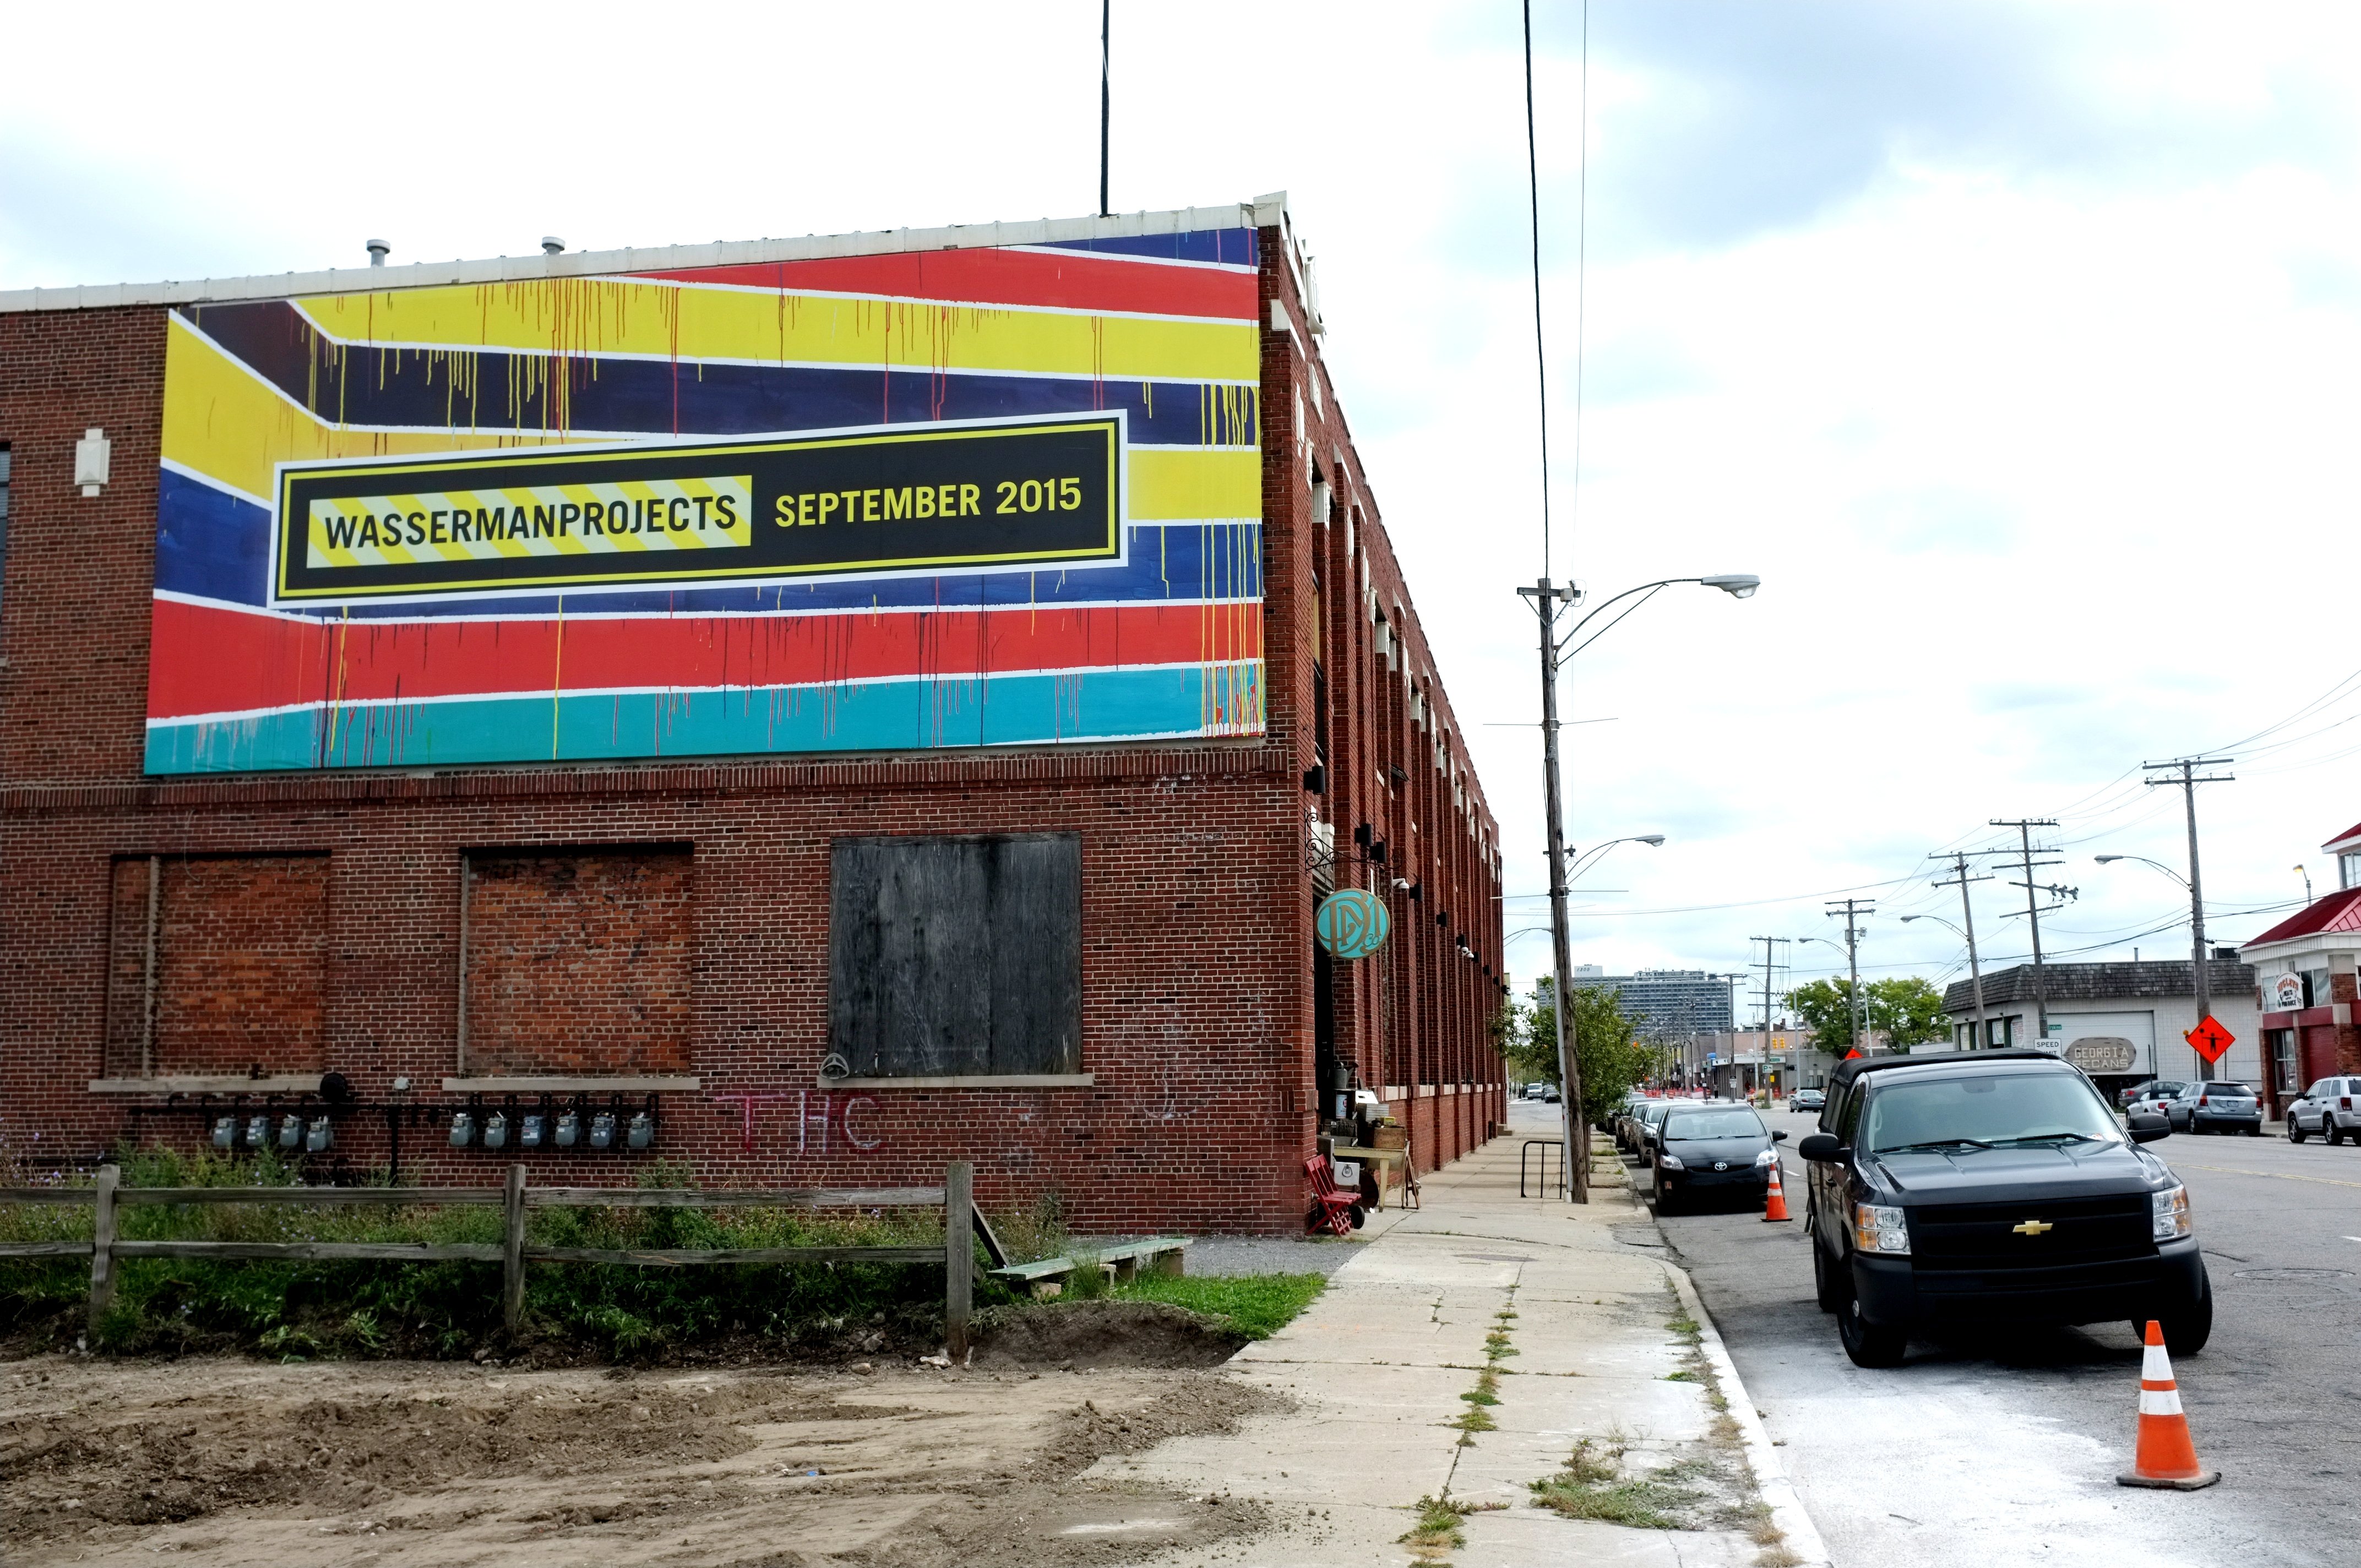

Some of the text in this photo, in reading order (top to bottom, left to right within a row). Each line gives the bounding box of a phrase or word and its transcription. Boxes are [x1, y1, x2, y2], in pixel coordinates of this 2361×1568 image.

[325, 477, 1081, 549] WASSERMANPROJECTS SEPTEMBER 2015
[2072, 1059, 2128, 1068] PECANS
[2074, 1047, 2129, 1058] GEORGIA
[715, 1090, 882, 1154] THC
